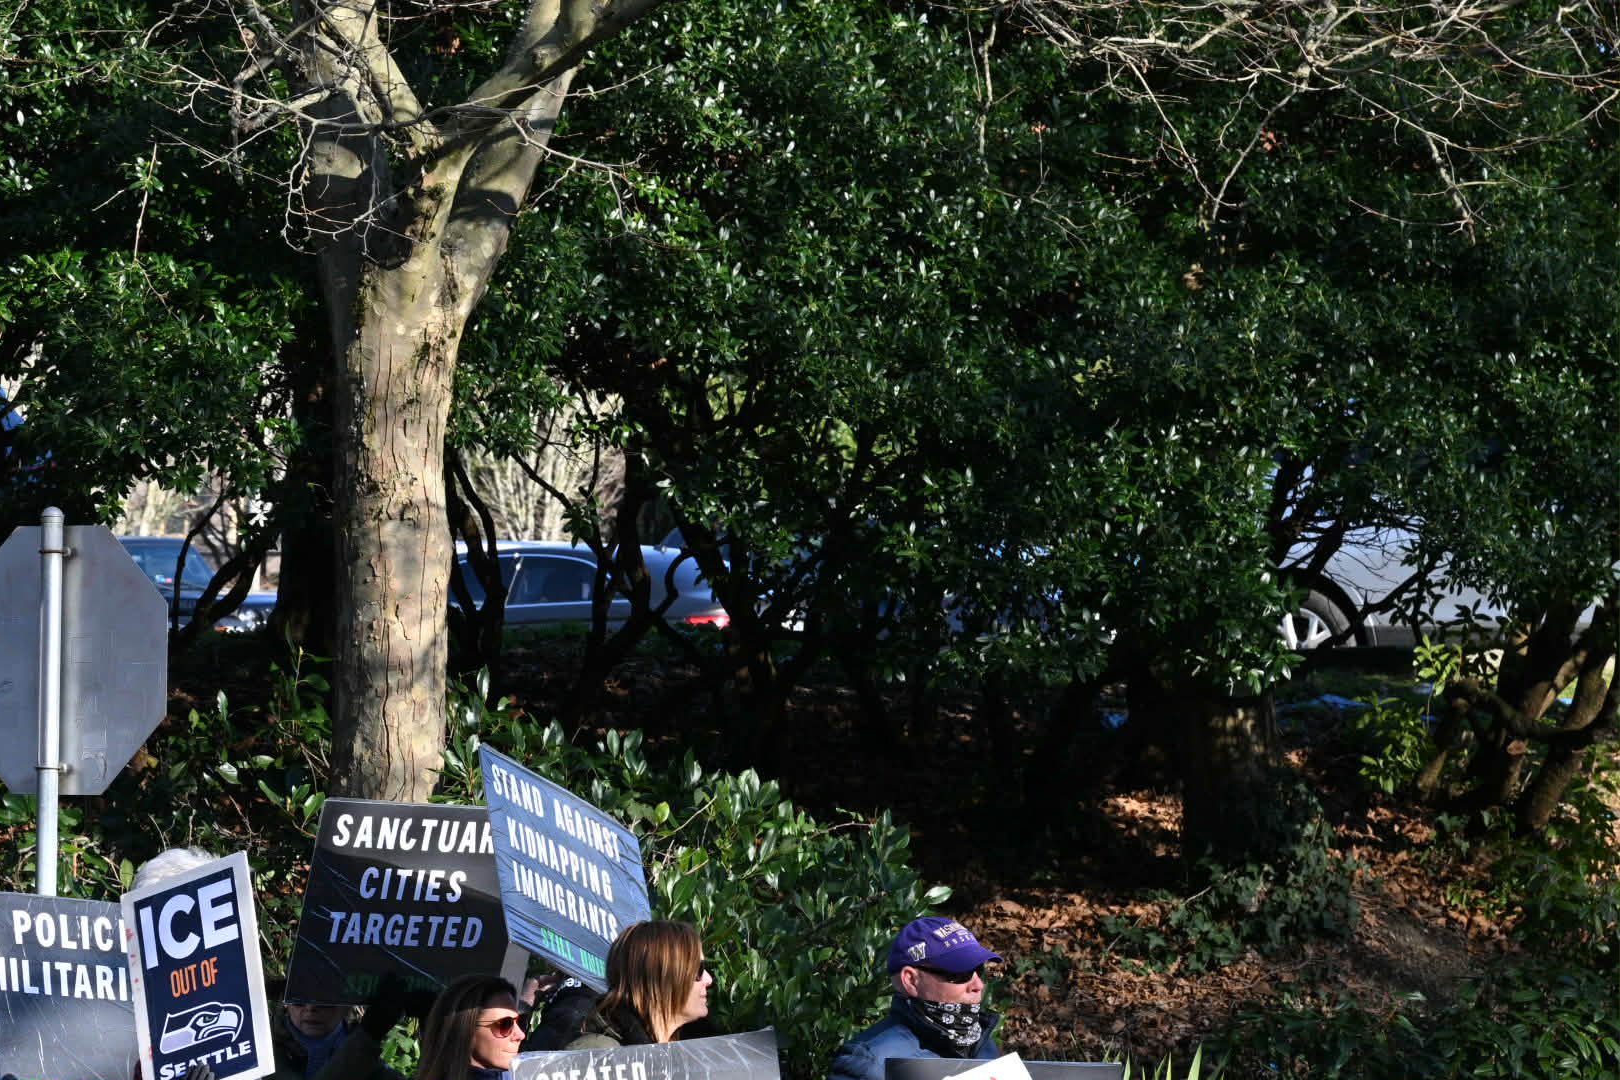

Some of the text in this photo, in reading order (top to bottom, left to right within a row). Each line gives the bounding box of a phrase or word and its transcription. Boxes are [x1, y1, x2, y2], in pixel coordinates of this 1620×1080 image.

[491, 763, 621, 864] STAND AGAINST
[506, 816, 613, 903] KIDNAPPING
[359, 866, 467, 903] CITIES
[512, 860, 618, 943] IMMIGRANTS
[139, 878, 240, 970] ICE
[329, 911, 483, 948] TARGETED
[540, 927, 575, 963] STILL
[908, 942, 927, 961] W
[170, 957, 219, 998] OUT OF
